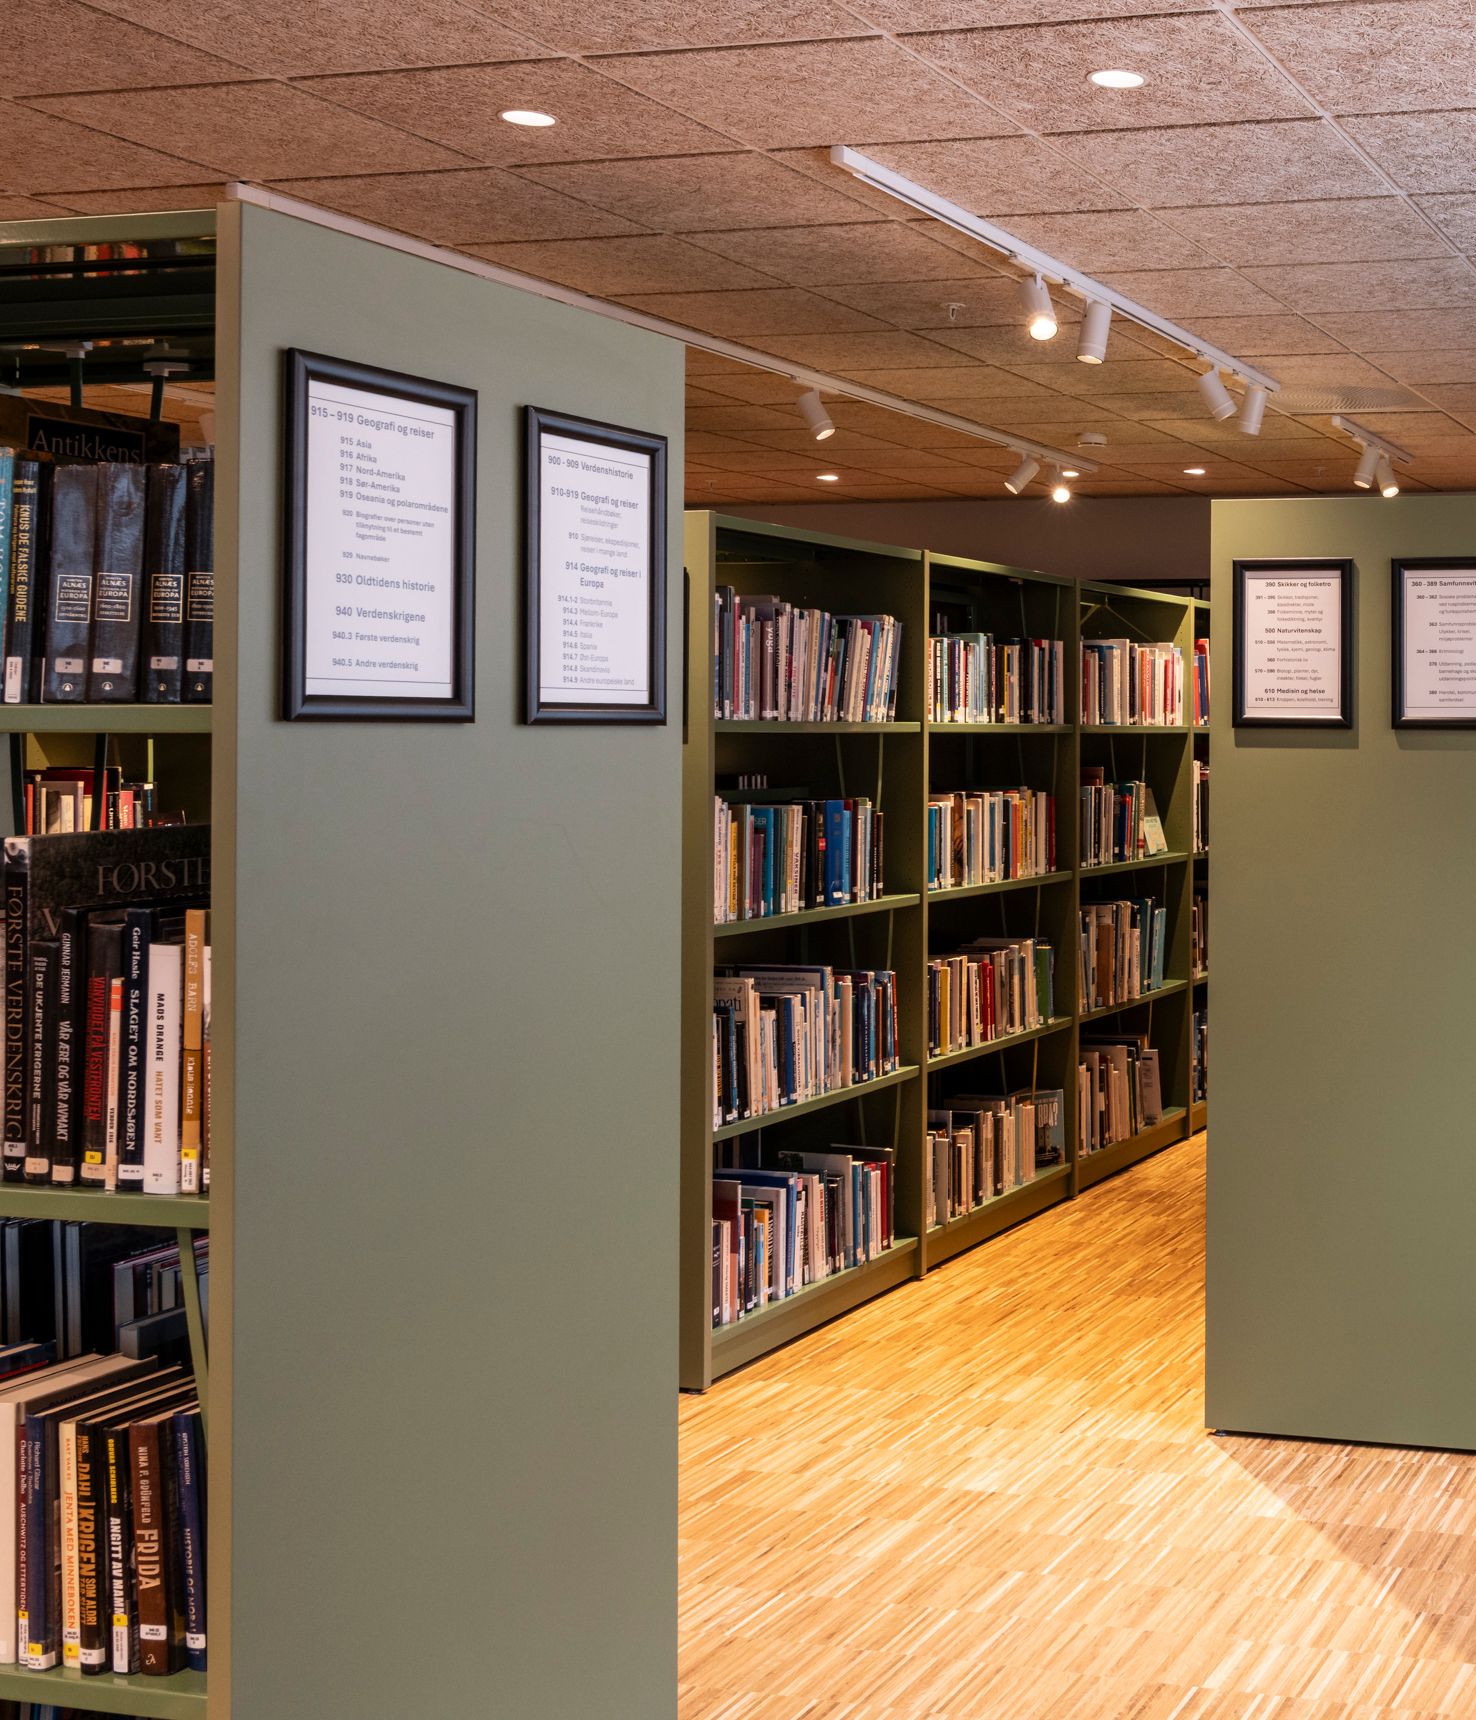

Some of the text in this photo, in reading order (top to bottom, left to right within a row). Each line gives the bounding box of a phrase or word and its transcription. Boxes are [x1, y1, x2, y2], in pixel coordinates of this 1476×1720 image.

[311, 405, 435, 439] 915 919 Geografi og reiser
[32, 429, 140, 464] Antikkens
[340, 436, 372, 449] 915 Asia
[339, 449, 377, 463] 916 Afrika
[548, 455, 633, 480] 900 909 Verdenshistorie
[339, 463, 405, 481] 917 Nord-Amerika
[339, 476, 400, 493] 918 Sør-Amerika
[339, 489, 448, 514] 919 Oseania og polarområdene
[551, 487, 638, 510] 910-919 Geografi og reiser
[15, 505, 29, 622] KNUS DE FALSKE GUDENE
[565, 561, 578, 572] 914
[580, 563, 609, 579] Geografi
[610, 567, 619, 579] og
[620, 568, 639, 578] reiser
[336, 573, 435, 593] 930 Oldtidens historie
[580, 578, 604, 589] Europa
[335, 605, 425, 623] 940 Verdenskrigene
[332, 631, 420, 646] 940.3 Første verdenskrig
[764, 627, 774, 653] yoga
[332, 657, 419, 671] 940.5 Andre verdenskrig
[97, 857, 210, 895] FØRSTE
[60, 933, 71, 1004] GUNNAR JERMANN
[187, 982, 198, 1012] BARN
[5, 886, 24, 1139] FØRSTE VERDENSKRIG
[33, 973, 43, 1099] DE UKJENTE KRIGERNE
[89, 977, 105, 1121] VANVIDDET PÅ VESTFRONTEN
[126, 927, 142, 1150] Geir Hasle SLAGET OM NORDSJØEN
[56, 1021, 72, 1141] VÅR ÆRE OG VÅR AVMAKT
[154, 993, 165, 1144] MADS DRANGE HATET SOM VANT
[186, 1057, 196, 1081] Klaus
[107, 1439, 116, 1464] ODDVAR
[138, 1446, 148, 1468] NINA
[77, 1463, 91, 1497] DAHL
[20, 1550, 26, 1562] OG
[78, 1509, 96, 1577] KRIGEN
[183, 1528, 193, 1575] HISTORIE
[64, 1491, 76, 1629] JENTA MED MINNEBOKEN
[110, 1517, 125, 1615] ANGITT AV MAMM
[136, 1529, 160, 1590] FRIDA
[85, 1578, 96, 1598] SOM
[185, 1578, 194, 1595] OG
[85, 1599, 97, 1625] ALDRI
